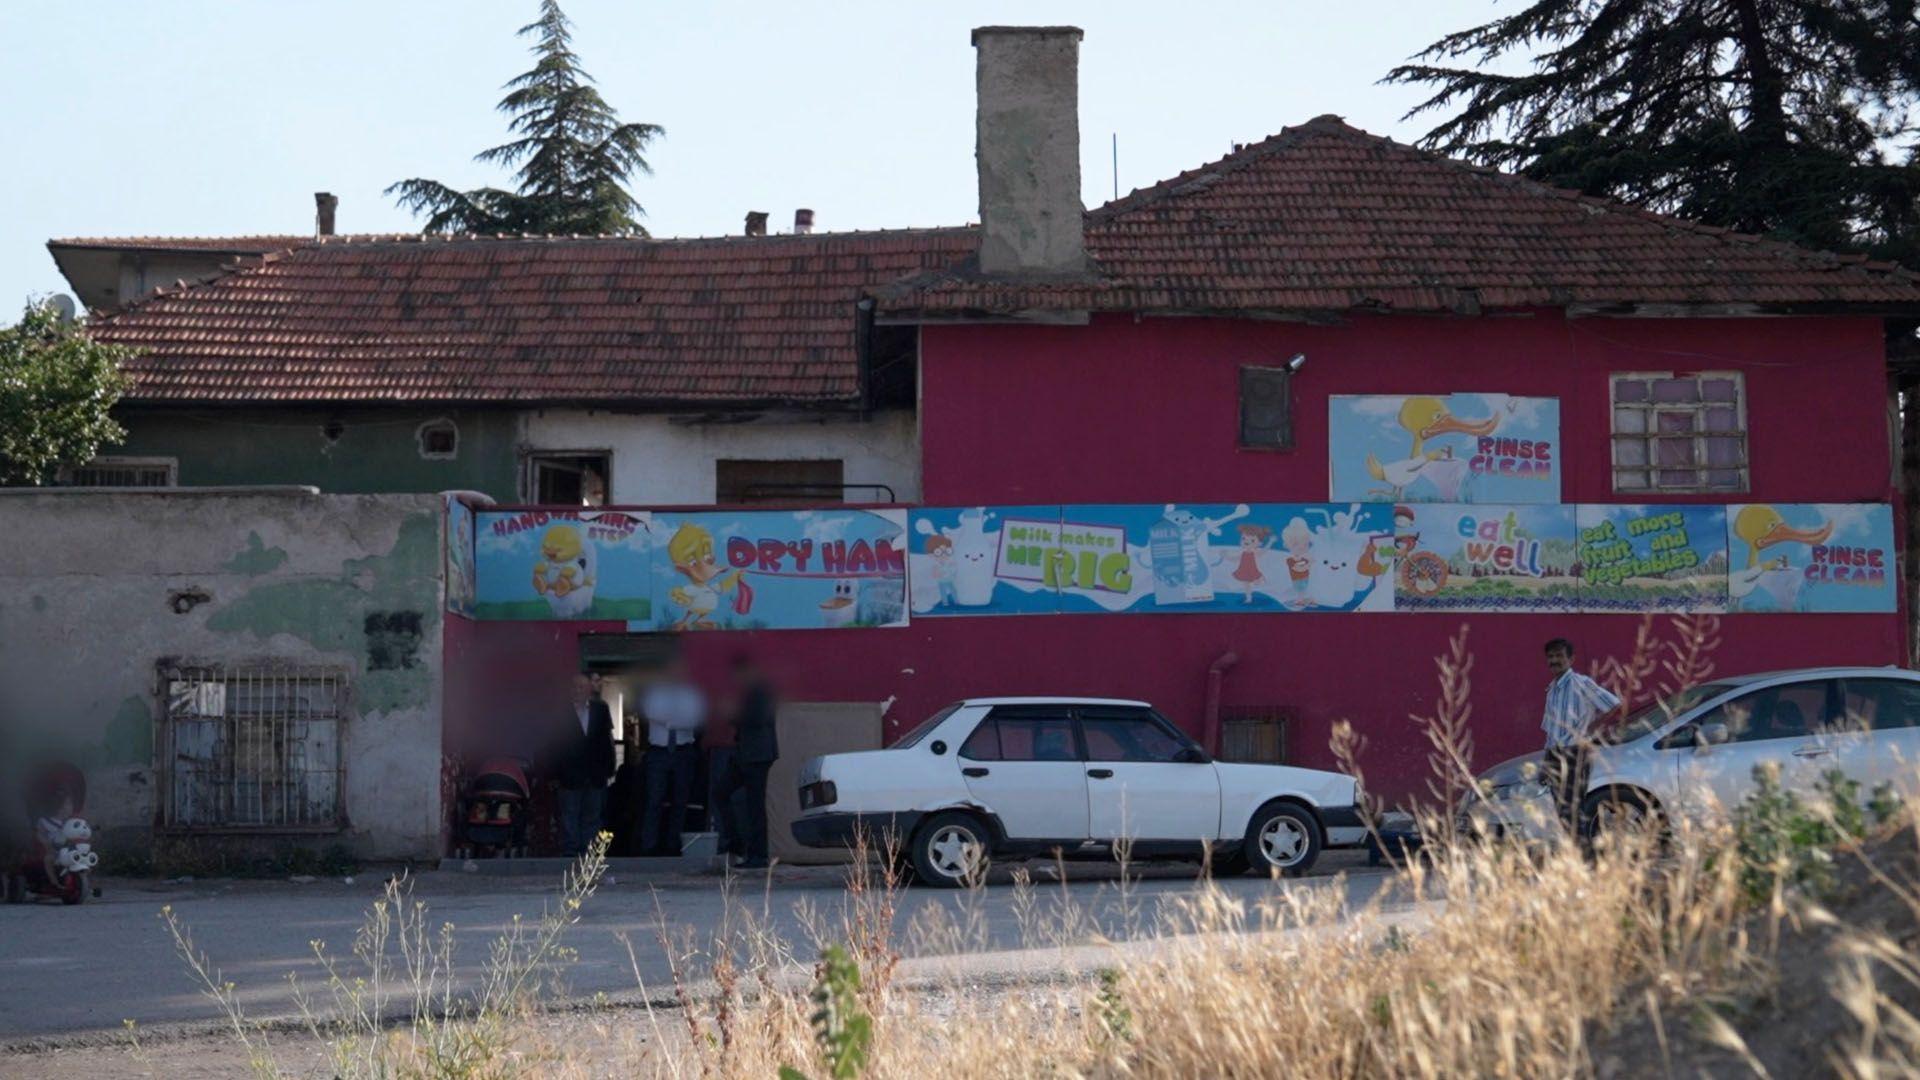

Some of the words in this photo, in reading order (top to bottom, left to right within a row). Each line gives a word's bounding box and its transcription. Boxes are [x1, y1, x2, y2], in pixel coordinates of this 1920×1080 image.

[1477, 436, 1552, 461] RINSE
[1469, 455, 1552, 480] CLEAN
[1009, 527, 1052, 543] Milk
[1059, 531, 1115, 548] makes
[1457, 511, 1517, 544] eat
[1582, 519, 1617, 543] eat
[1627, 512, 1684, 537] more
[727, 536, 813, 572] DRY
[1467, 540, 1541, 575] well
[1581, 538, 1633, 567] fruit
[1651, 528, 1688, 551] and
[1811, 544, 1884, 568] RINSE
[1583, 550, 1700, 585] vegetables
[1804, 564, 1885, 588] CLEAN
